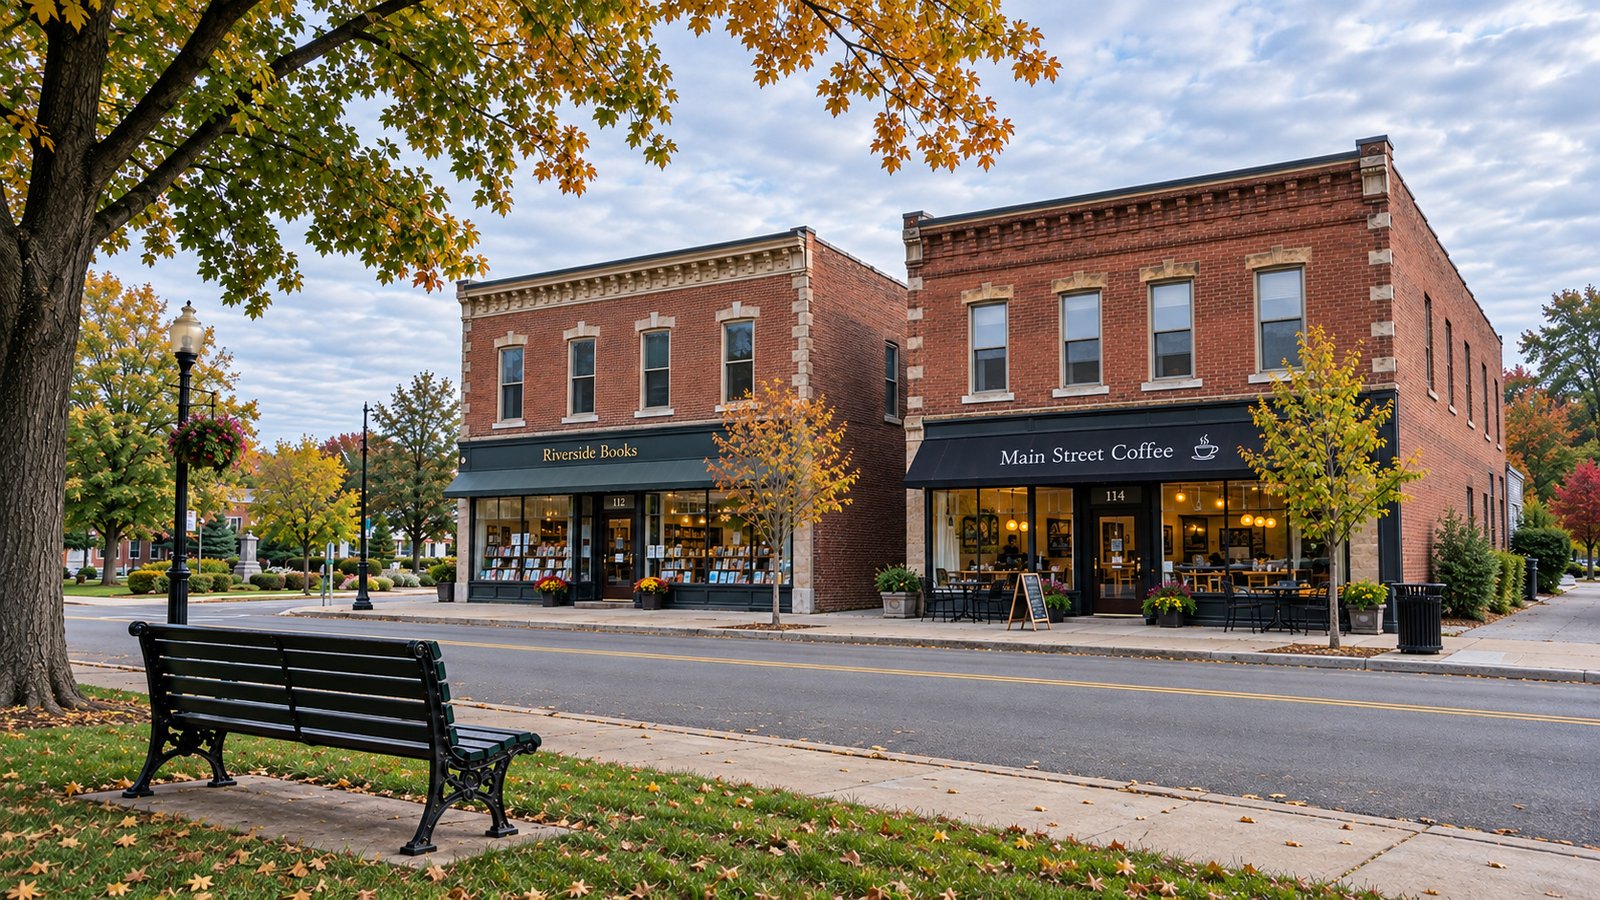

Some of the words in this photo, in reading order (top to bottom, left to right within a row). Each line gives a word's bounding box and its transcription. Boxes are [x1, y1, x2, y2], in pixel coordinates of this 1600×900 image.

[543, 445, 596, 462] Riverside
[600, 443, 638, 459] Books
[999, 449, 1046, 465] Main
[1052, 447, 1105, 463] Street
[1111, 441, 1174, 461] Coffee
[613, 497, 626, 507] 112
[1106, 491, 1125, 502] 114
